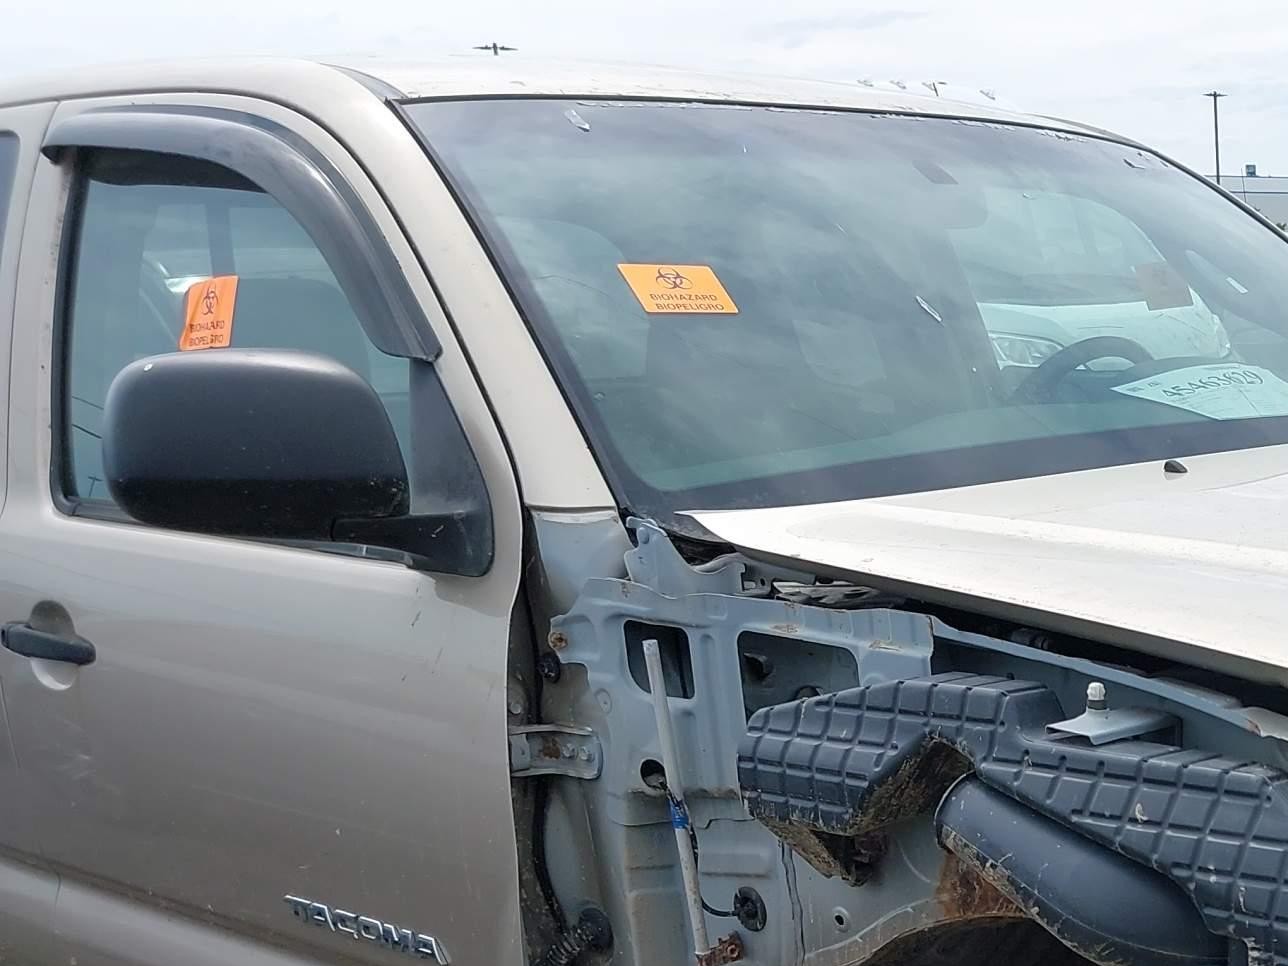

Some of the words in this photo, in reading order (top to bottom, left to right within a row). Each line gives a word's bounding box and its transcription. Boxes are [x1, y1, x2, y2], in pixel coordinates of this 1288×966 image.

[649, 293, 718, 301] BIOHAZARD
[655, 303, 725, 311] BIOPELIGRO
[1160, 369, 1265, 398] 45463629
[283, 894, 452, 966] TACOMA
